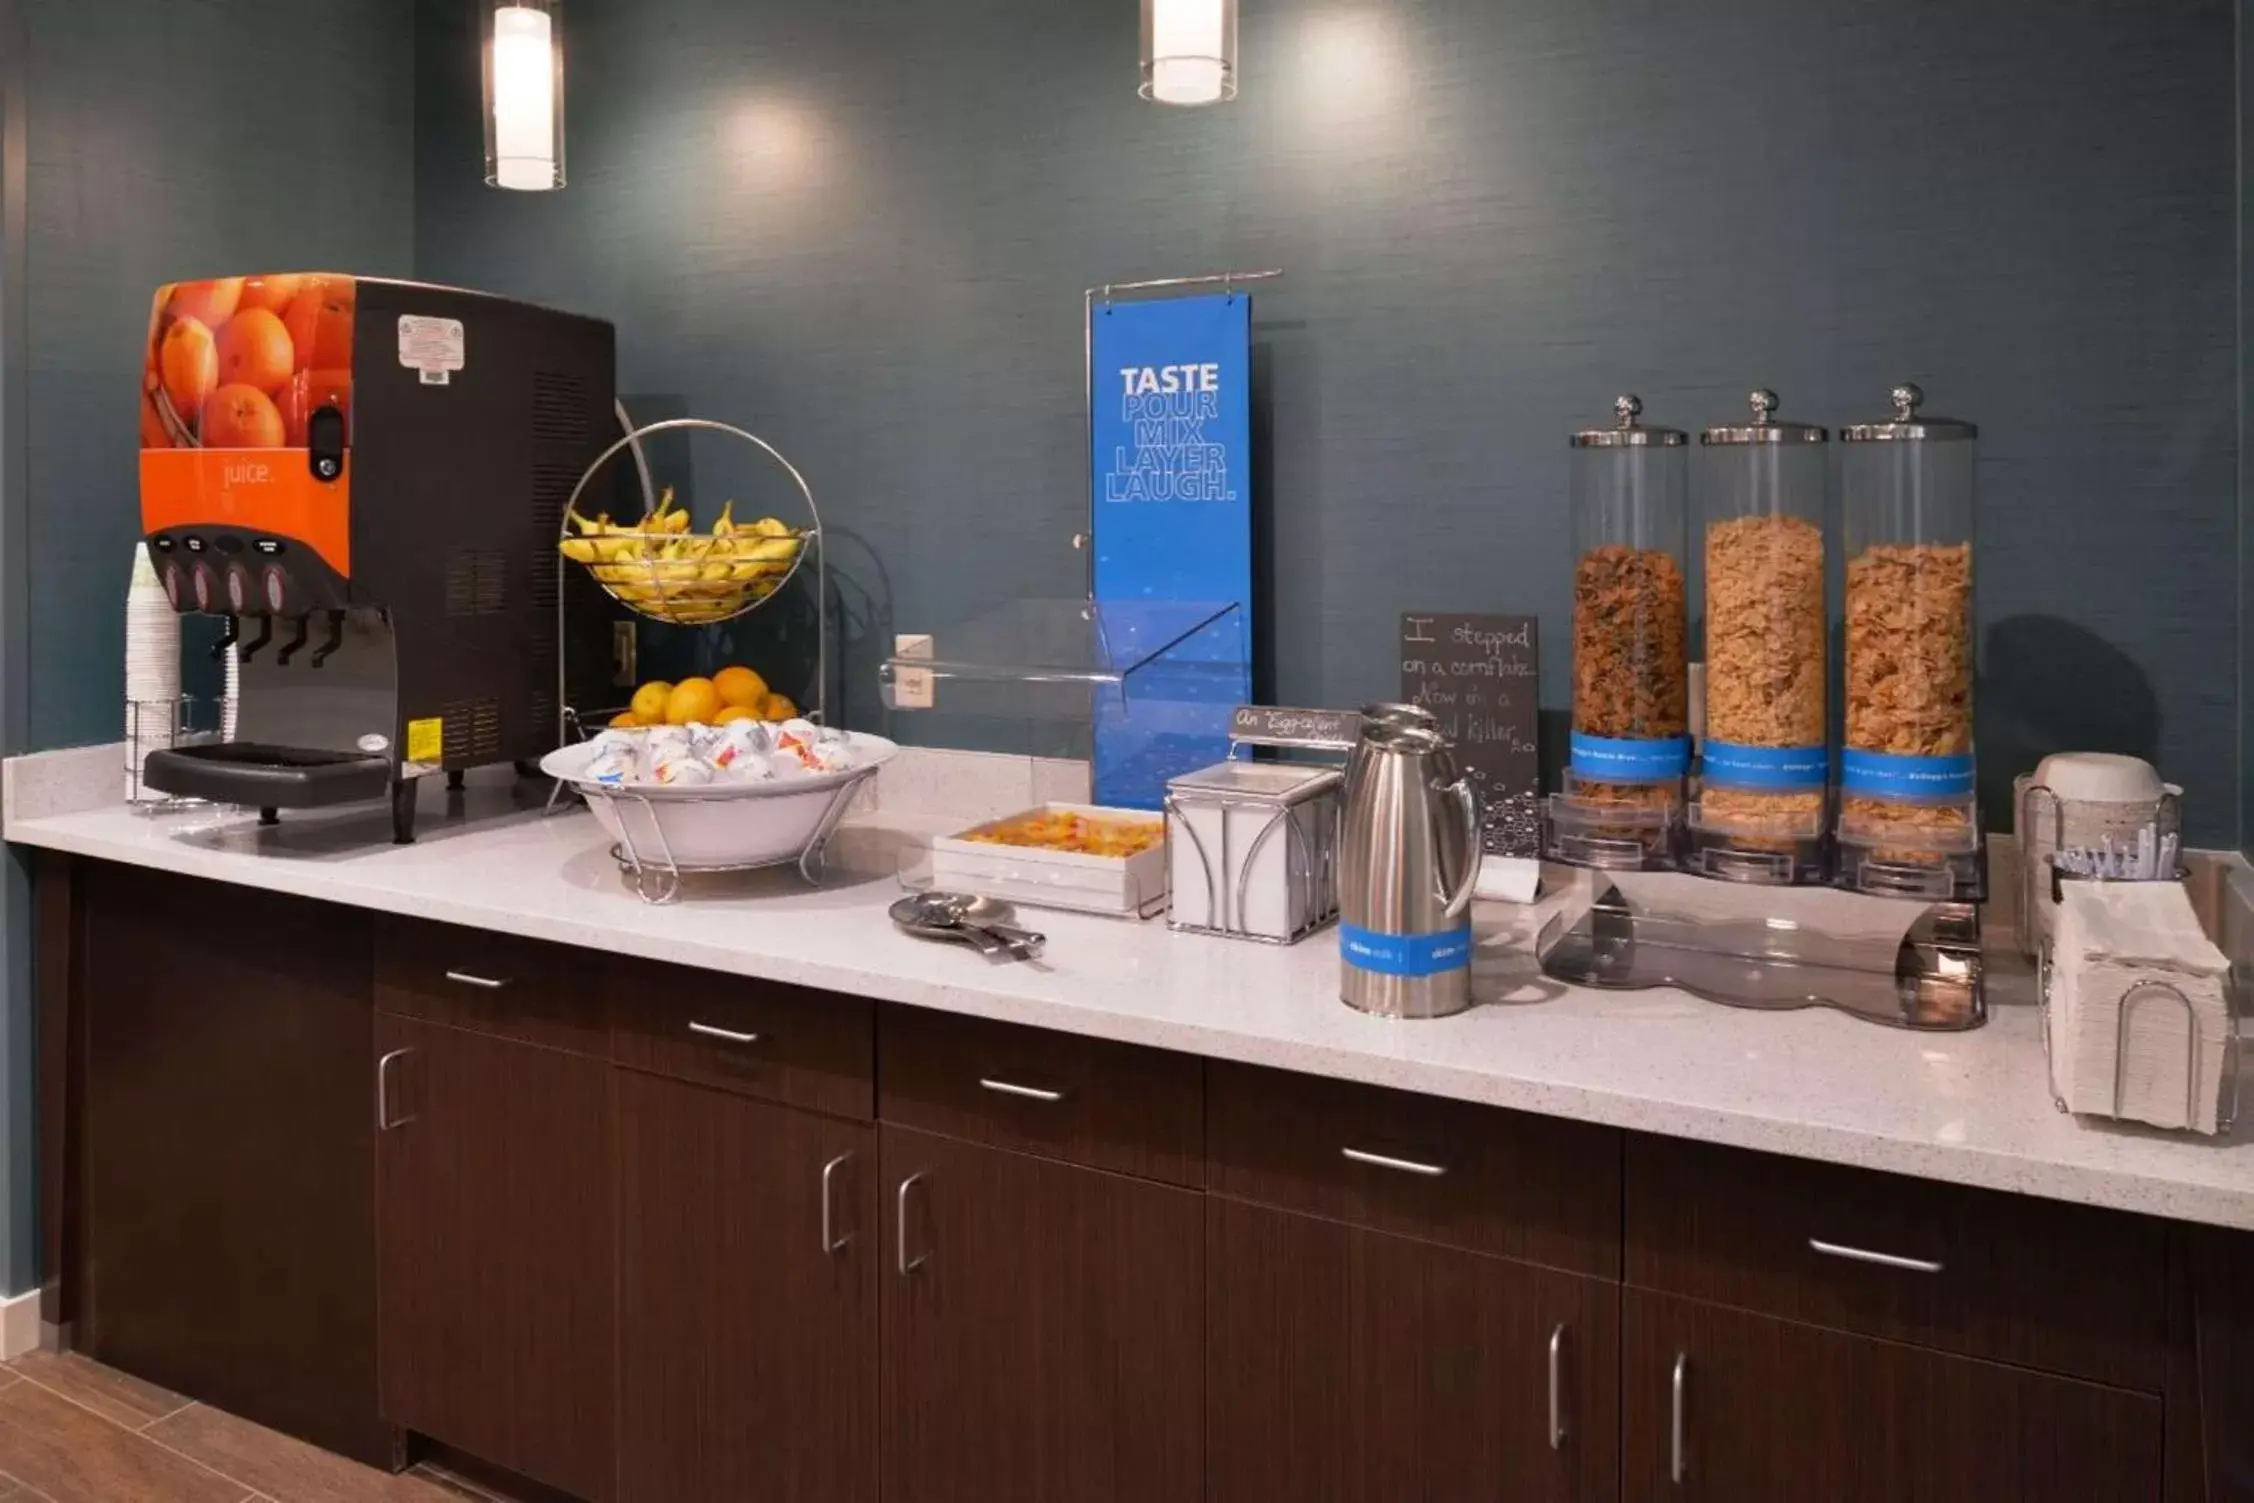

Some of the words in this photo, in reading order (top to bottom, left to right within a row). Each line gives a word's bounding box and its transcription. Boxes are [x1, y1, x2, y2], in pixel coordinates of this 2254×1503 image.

[1120, 363, 1219, 395] TASTE
[1122, 389, 1218, 422] POUR
[1134, 416, 1205, 448] MIX
[1115, 443, 1228, 475] LAYER
[1105, 470, 1236, 502] LAUGH.
[1404, 617, 1436, 642] I
[1450, 622, 1530, 655] stepped
[1402, 659, 1427, 676] on
[1431, 661, 1446, 676] a
[1498, 693, 1512, 708] a
